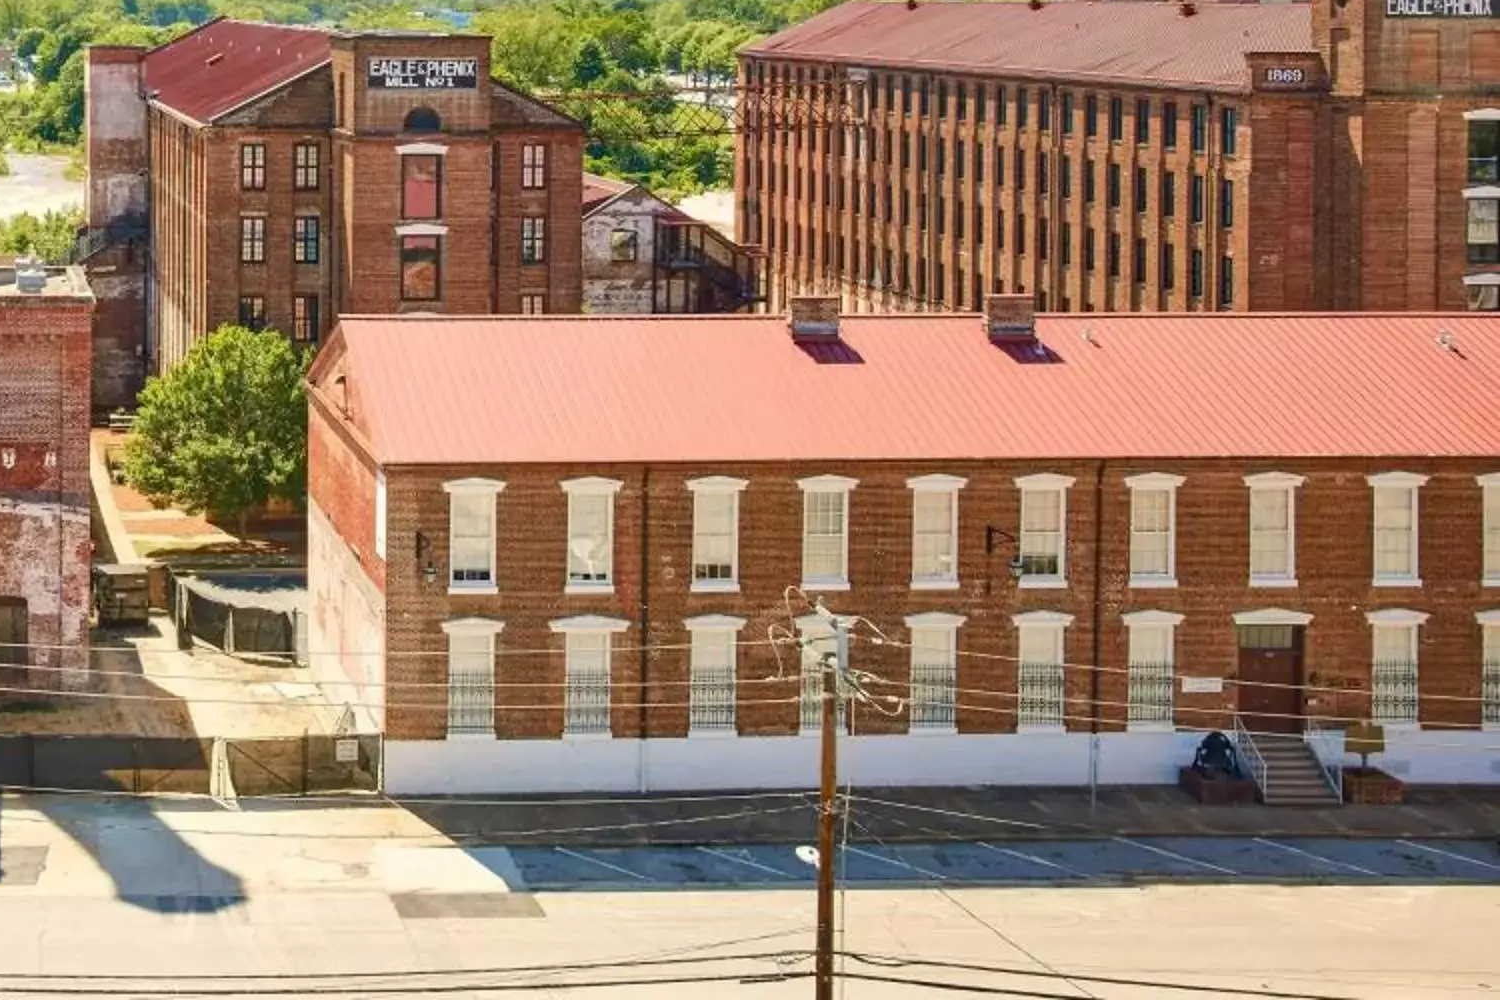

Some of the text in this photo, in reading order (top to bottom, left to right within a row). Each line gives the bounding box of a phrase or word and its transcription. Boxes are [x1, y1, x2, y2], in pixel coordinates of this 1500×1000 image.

[369, 60, 417, 77] EAGLE
[427, 60, 475, 77] PHENIX
[385, 77, 418, 87] MILL
[447, 77, 455, 87] 1
[1267, 69, 1303, 82] 1869
